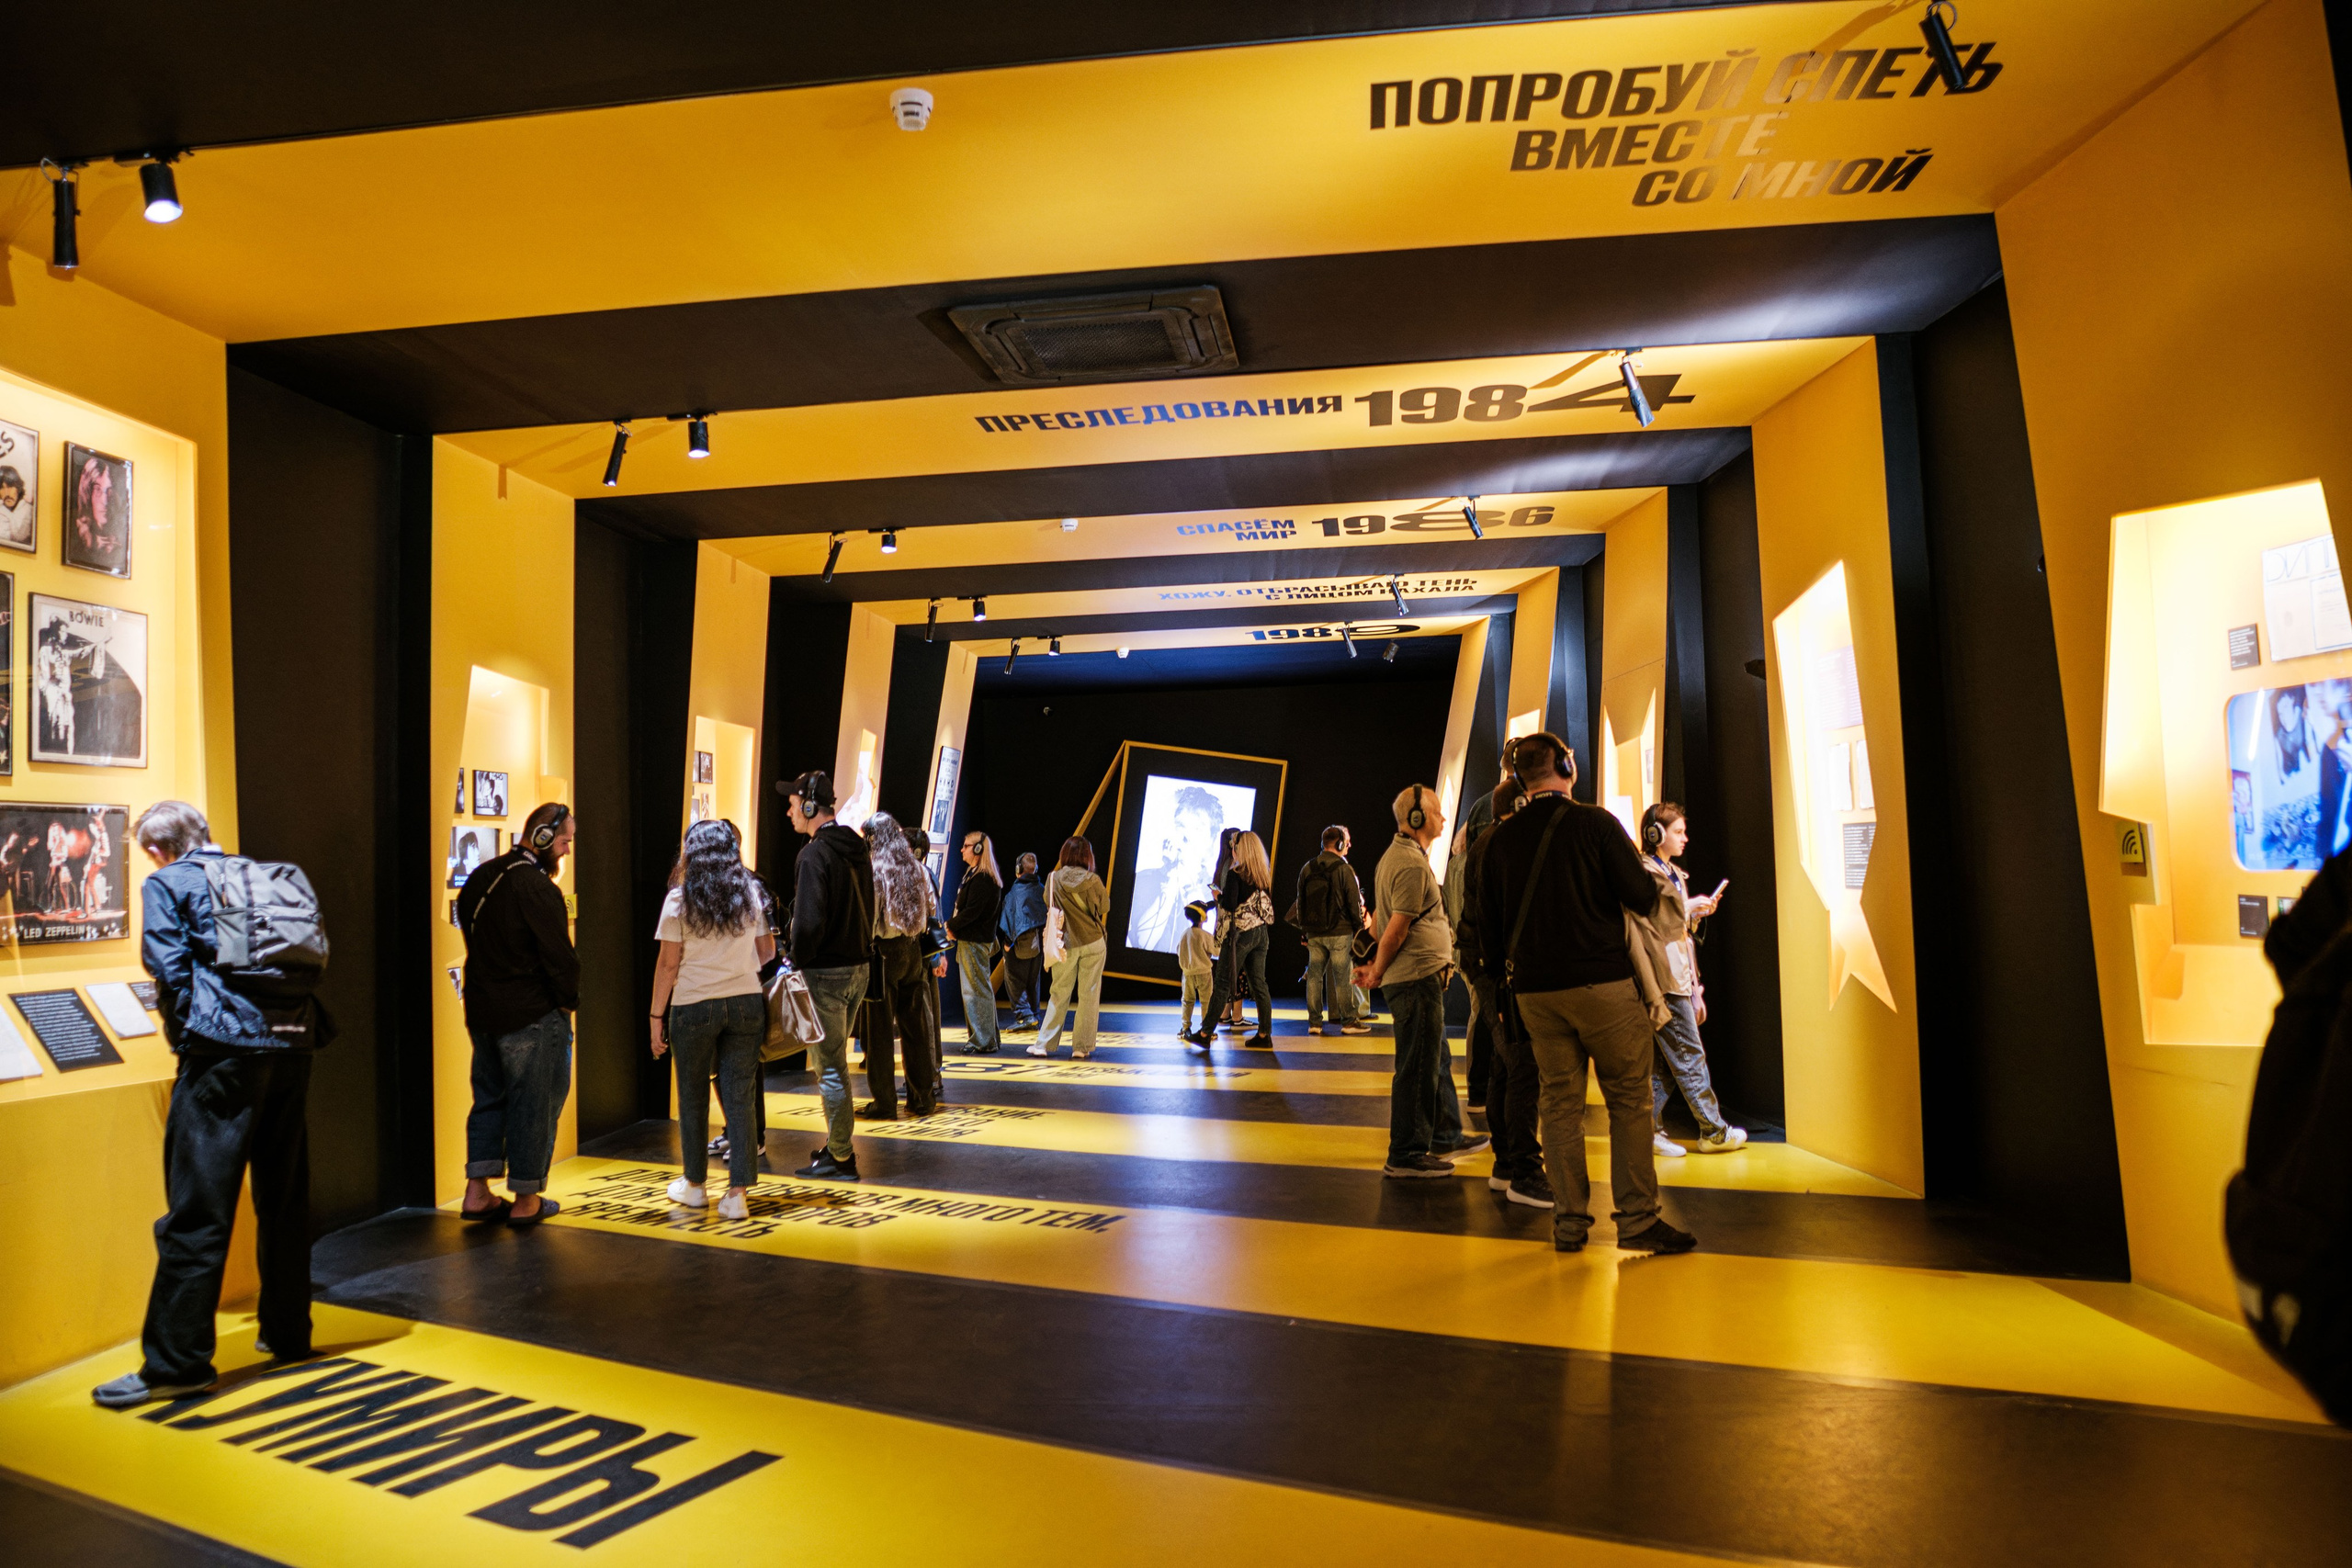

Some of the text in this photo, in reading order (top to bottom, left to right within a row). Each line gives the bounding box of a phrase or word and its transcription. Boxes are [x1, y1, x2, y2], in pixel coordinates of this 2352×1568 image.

[1369, 42, 2004, 130] ПОПРОБУЙ СПЕТЬ
[1510, 112, 1790, 172] ВМЕСТЕ
[1632, 148, 1933, 207] СО МНОЙ
[975, 374, 1696, 433] ПРЕСЛЕДОВАНИЯ 1984
[1177, 506, 1555, 537] СПАСЁМ 1986
[1236, 530, 1296, 541] МИР
[1285, 588, 1373, 600] ЛИЦОМ
[1416, 578, 1477, 587] ТЕНЬ
[68, 608, 104, 628] BOWIE
[24, 924, 85, 939] LED ZEPPELIN
[865, 1124, 983, 1139] СТИЛЯ
[568, 1184, 666, 1203] ДЛЯ
[589, 1168, 678, 1186] ДЛЯ
[883, 1197, 1035, 1223] МНОГО
[1023, 1209, 1128, 1235] ТЕМ,
[560, 1201, 783, 1239] ВРЕМЯ ЕСТЬ
